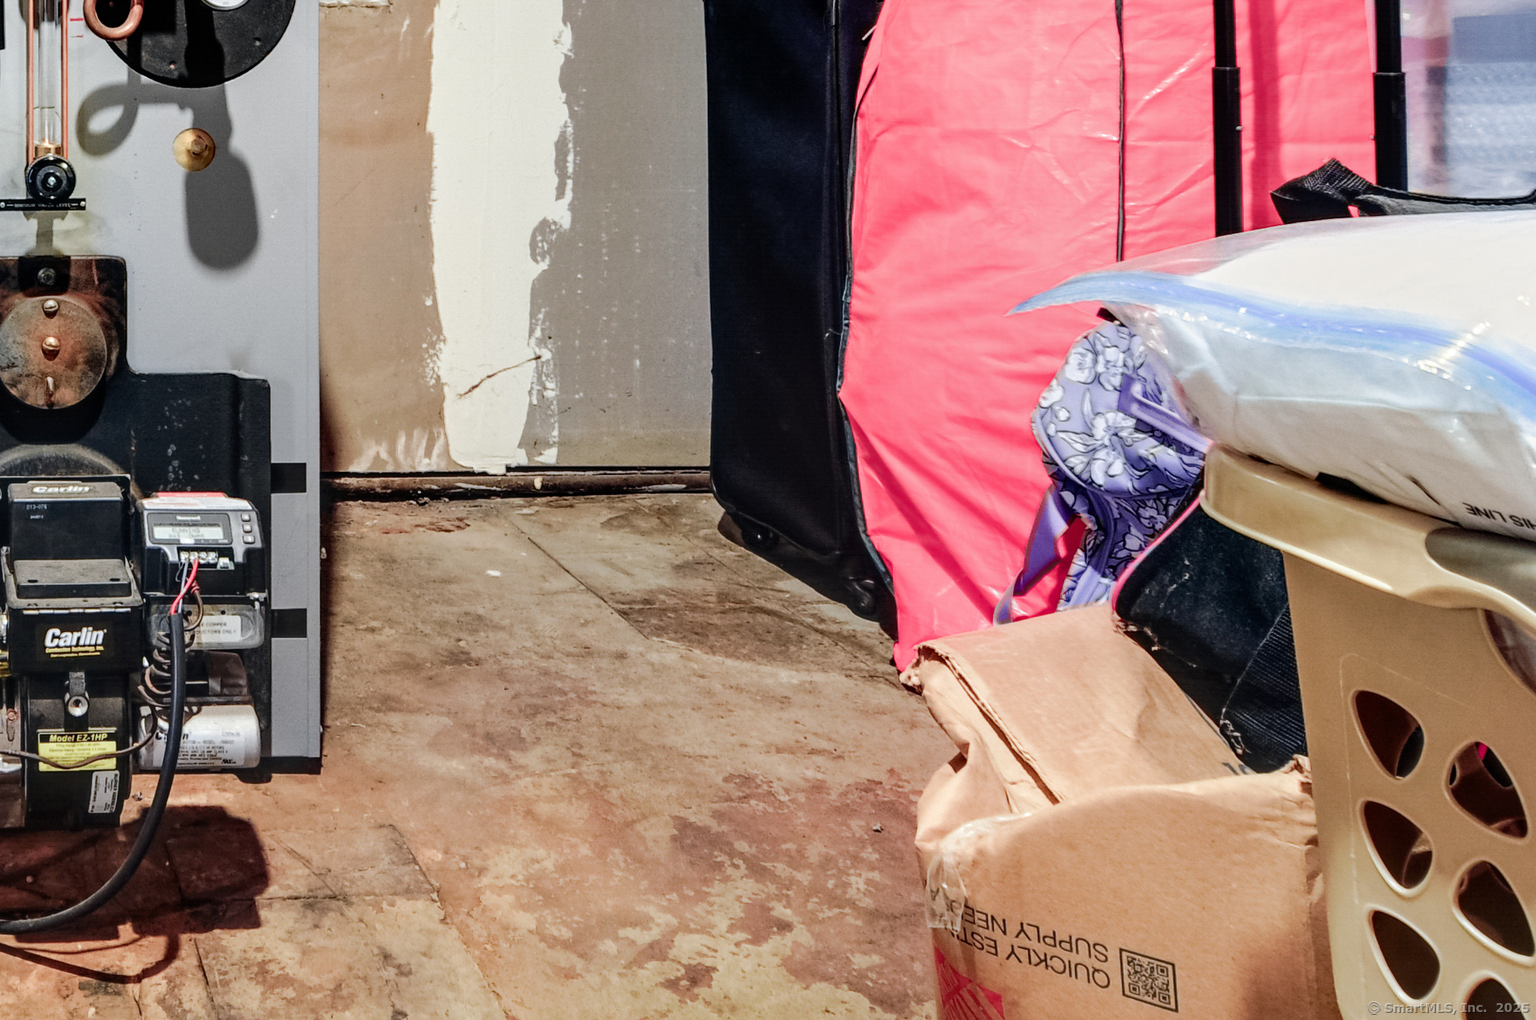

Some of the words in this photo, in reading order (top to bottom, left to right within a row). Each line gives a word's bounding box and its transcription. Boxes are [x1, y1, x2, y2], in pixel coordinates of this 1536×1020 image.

[32, 486, 91, 494] Carlin
[1462, 502, 1507, 523] LINE
[45, 626, 104, 647] Carlin
[49, 734, 75, 742] Model
[76, 733, 108, 741] EZ-1HP
[1015, 922, 1109, 963] SUPPLY
[1006, 945, 1111, 989] QUICKLY
